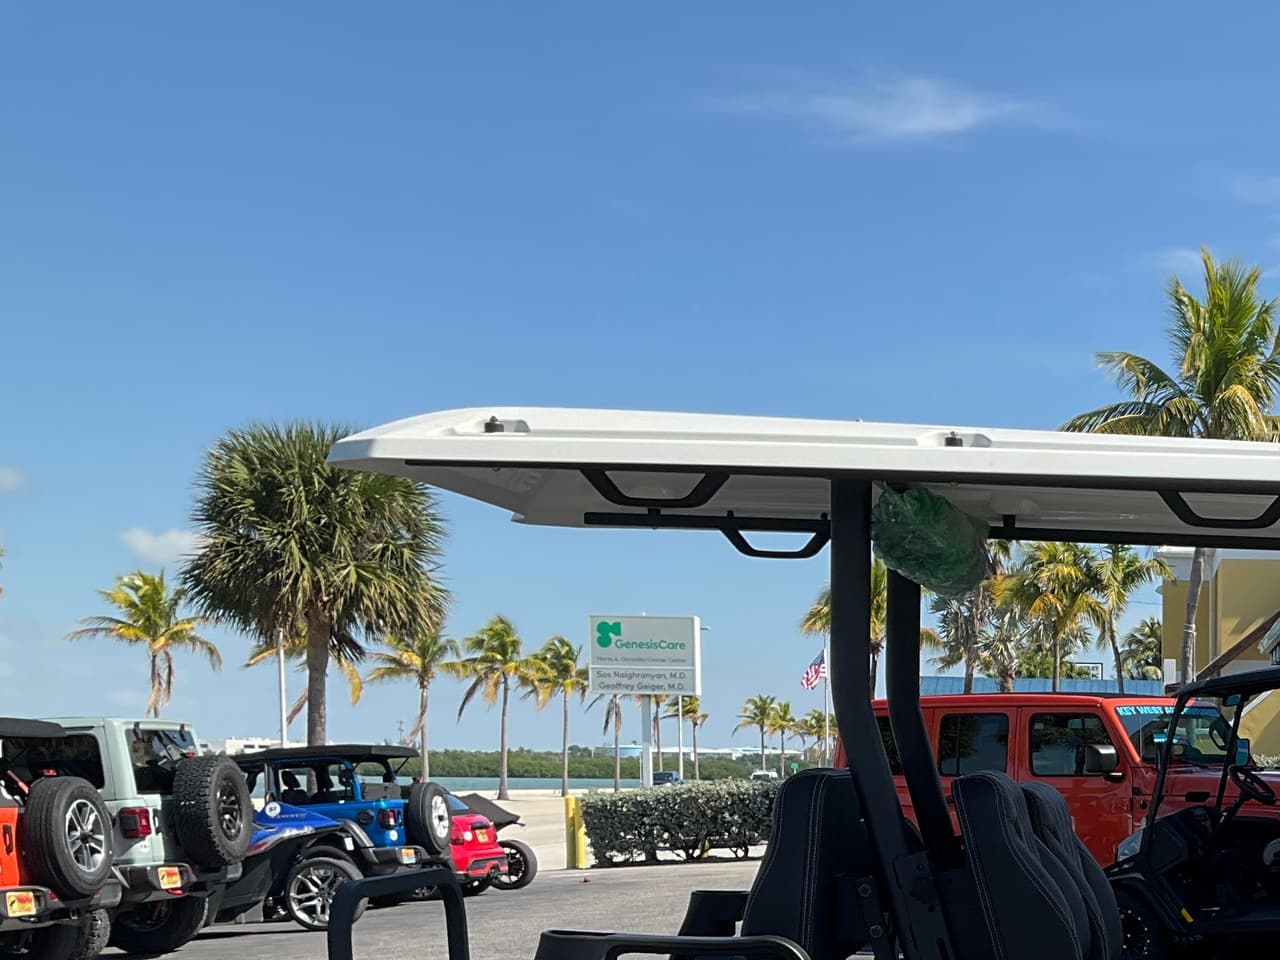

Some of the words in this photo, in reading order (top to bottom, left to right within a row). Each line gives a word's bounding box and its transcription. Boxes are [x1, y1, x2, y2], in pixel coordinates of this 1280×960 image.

[615, 639, 686, 650] GenesisCare
[1116, 706, 1137, 716] KEY
[1136, 706, 1164, 715] WEST
